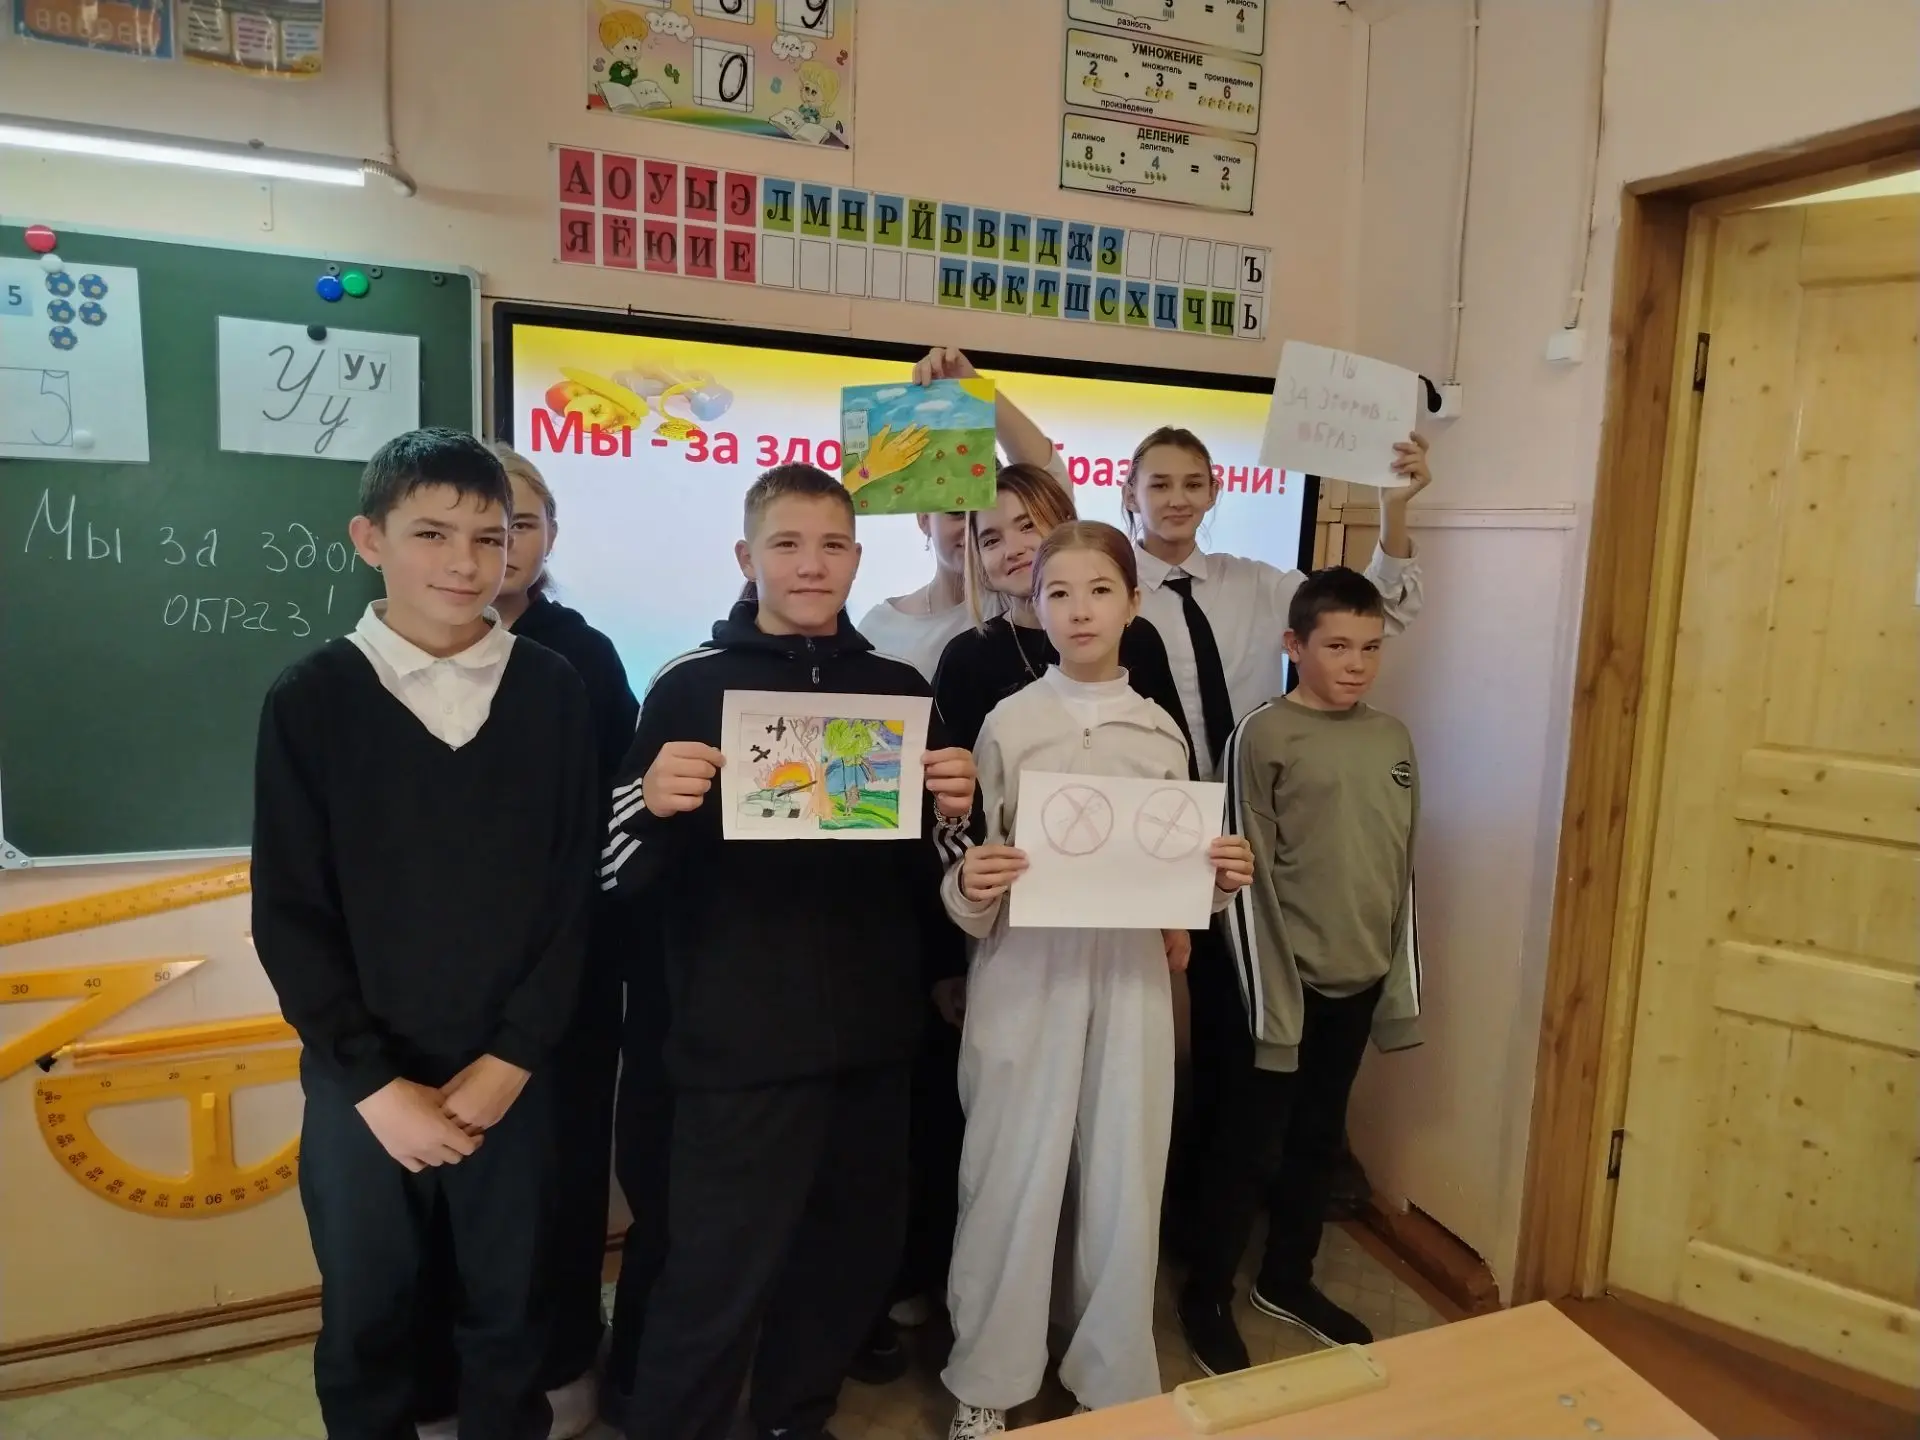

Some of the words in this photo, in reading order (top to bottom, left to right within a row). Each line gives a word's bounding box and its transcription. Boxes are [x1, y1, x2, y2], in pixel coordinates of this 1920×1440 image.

[1117, 17, 1152, 31] разность
[1236, 8, 1244, 23] 4
[1075, 49, 1118, 63] множитель
[1132, 43, 1203, 66] УМНОЖЕНИЕ
[1142, 61, 1182, 75] множитель
[719, 54, 748, 103] 0
[1089, 61, 1098, 76] 2
[1156, 73, 1164, 87] 3
[1223, 85, 1231, 99] 6
[1204, 73, 1253, 88] произведение
[1101, 100, 1153, 114] произведение
[1071, 132, 1105, 143] делимое
[1137, 127, 1190, 145] ДЕЛЕНИЕ
[1140, 142, 1174, 154] делитель
[1085, 146, 1093, 160] 8
[1151, 155, 1160, 170] 4
[1221, 167, 1230, 181] 2
[1213, 154, 1241, 165] частное
[1106, 184, 1136, 194] частное
[564, 160, 592, 195] А
[608, 166, 632, 200] О
[648, 171, 673, 205] У
[685, 176, 717, 212] Ы
[730, 183, 751, 216] Э
[766, 189, 792, 222] Л
[803, 194, 831, 227] М
[841, 199, 865, 232] Н
[878, 204, 898, 235] Р
[911, 202, 935, 241] Й
[944, 213, 962, 244] Б
[977, 218, 995, 248] В
[1009, 223, 1026, 252] Г
[1038, 228, 1058, 265] Д
[1067, 231, 1092, 262] Ж
[1101, 236, 1117, 265] З
[1245, 256, 1262, 283] Ъ
[565, 220, 592, 253] Я
[609, 218, 631, 258] Ё
[644, 230, 677, 264] Ю
[688, 235, 715, 268] И
[730, 241, 750, 273] Е
[941, 267, 964, 298] П
[972, 272, 996, 301] Ф
[1005, 275, 1024, 306] К
[1038, 279, 1056, 308] Т
[1065, 282, 1091, 312] Ш
[1100, 287, 1116, 315] С
[1127, 290, 1147, 319] Х
[1156, 293, 1177, 328] Ц
[1186, 297, 1204, 325] Ч
[1211, 300, 1234, 334] Щ
[1243, 304, 1258, 330] Ь
[8, 285, 22, 306] 5
[31, 370, 71, 446] 5
[530, 407, 632, 458] Мы
[685, 429, 738, 464] за
[756, 435, 842, 471] здо
[1211, 464, 1286, 495] зни!
[25, 488, 121, 563] Мы
[160, 526, 218, 567] за
[11, 984, 29, 995] 30
[84, 977, 101, 989] 40
[154, 971, 171, 981] 50
[168, 1072, 180, 1080] 20
